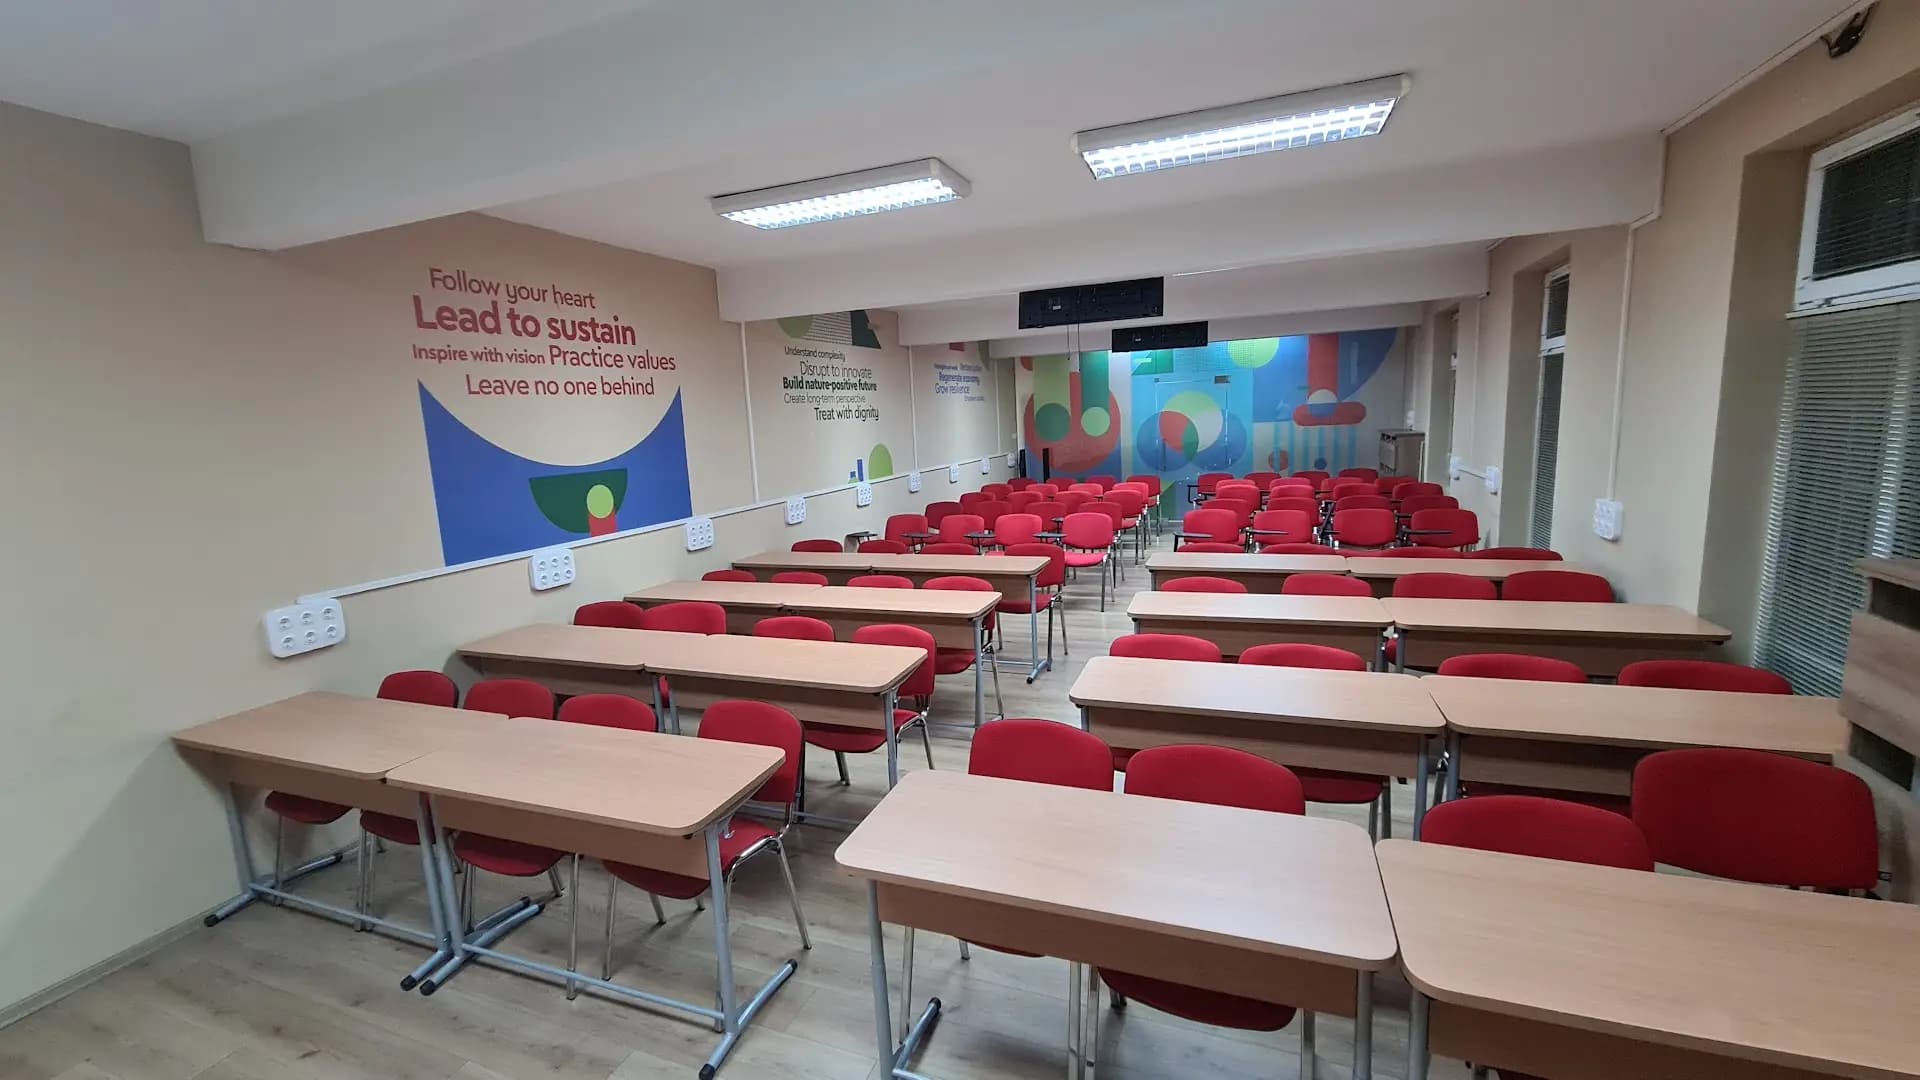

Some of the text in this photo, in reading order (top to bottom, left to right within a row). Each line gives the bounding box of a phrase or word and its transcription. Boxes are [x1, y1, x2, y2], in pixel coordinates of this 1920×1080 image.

[429, 267, 595, 308] Follow your heart
[413, 295, 636, 345] Lead to sustain
[413, 344, 676, 371] Inspire with vision Practice values
[785, 346, 817, 358] Understand
[800, 361, 872, 379] Disrupt to innovate
[466, 374, 654, 395] Leave no one behind
[783, 376, 877, 392] Build nature-positive future
[784, 393, 866, 406] Create long-term perspective
[814, 405, 879, 422] Treat with dignity
